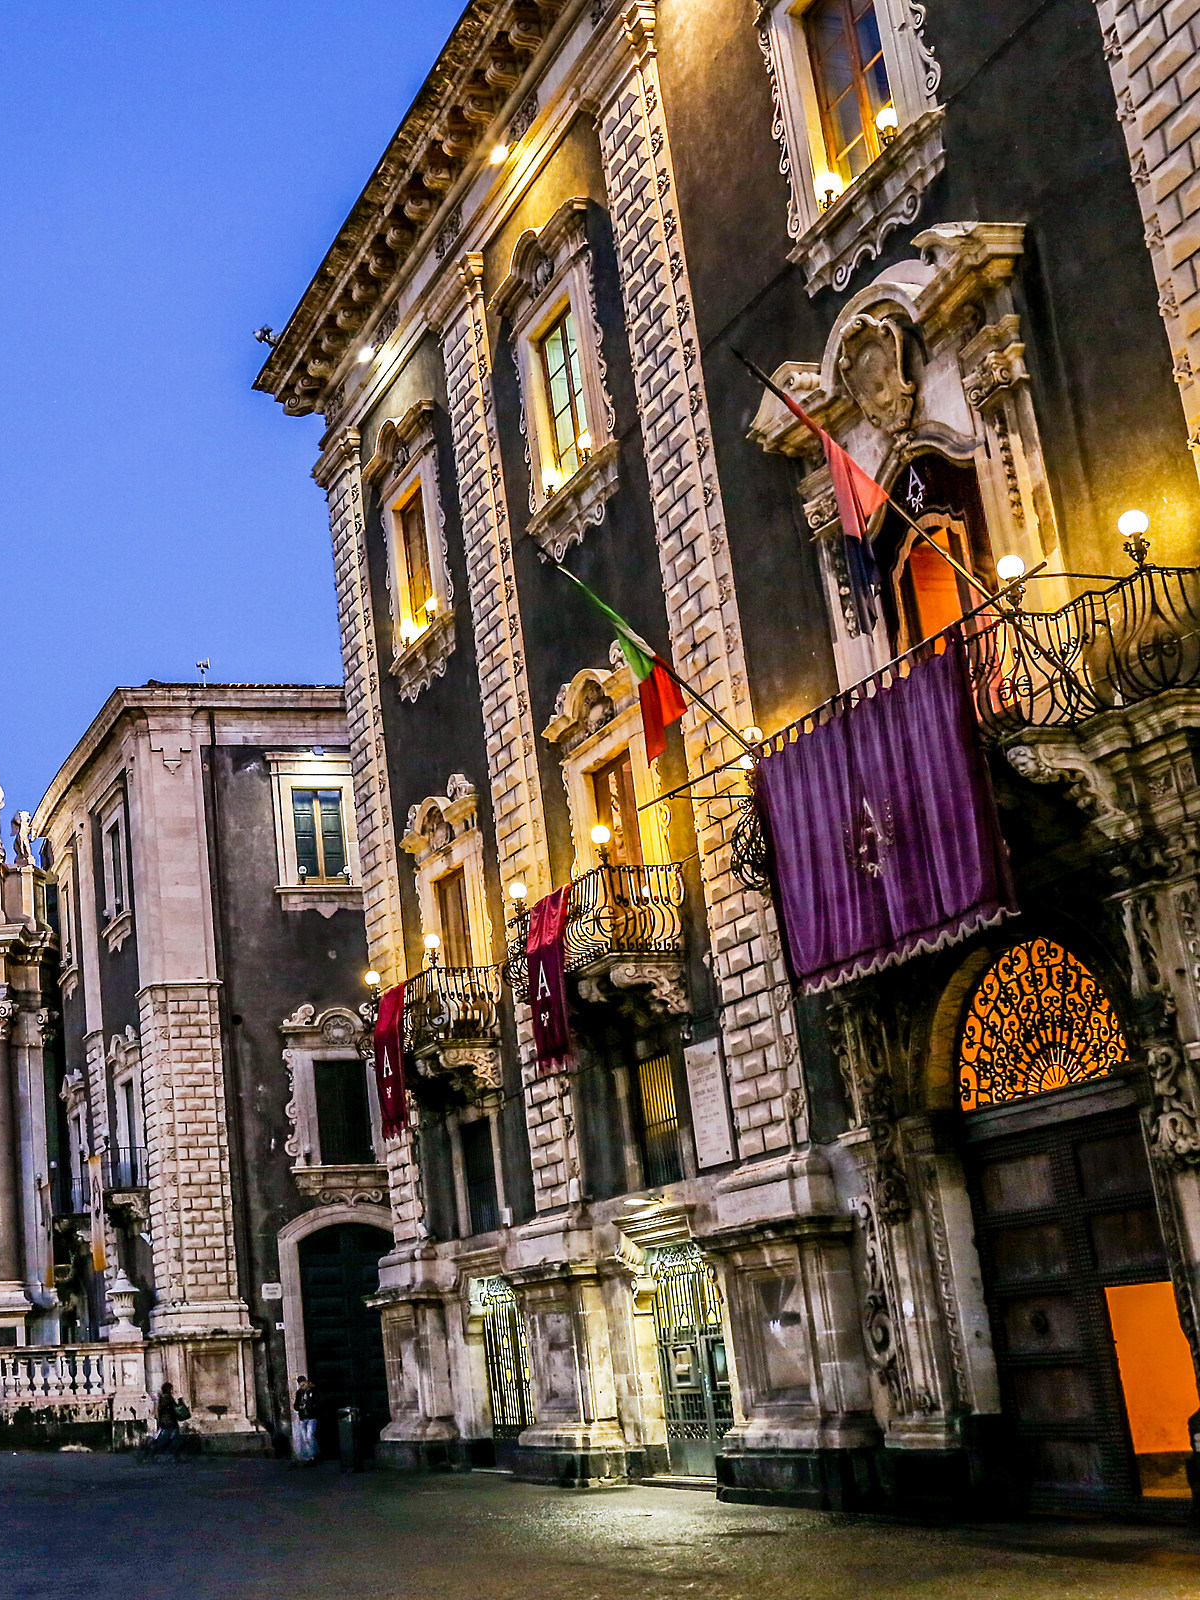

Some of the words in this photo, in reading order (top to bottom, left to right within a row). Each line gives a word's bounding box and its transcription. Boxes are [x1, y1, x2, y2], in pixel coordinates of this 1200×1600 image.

[906, 465, 925, 501] A
[536, 960, 551, 1001] A
[382, 1045, 393, 1078] A
